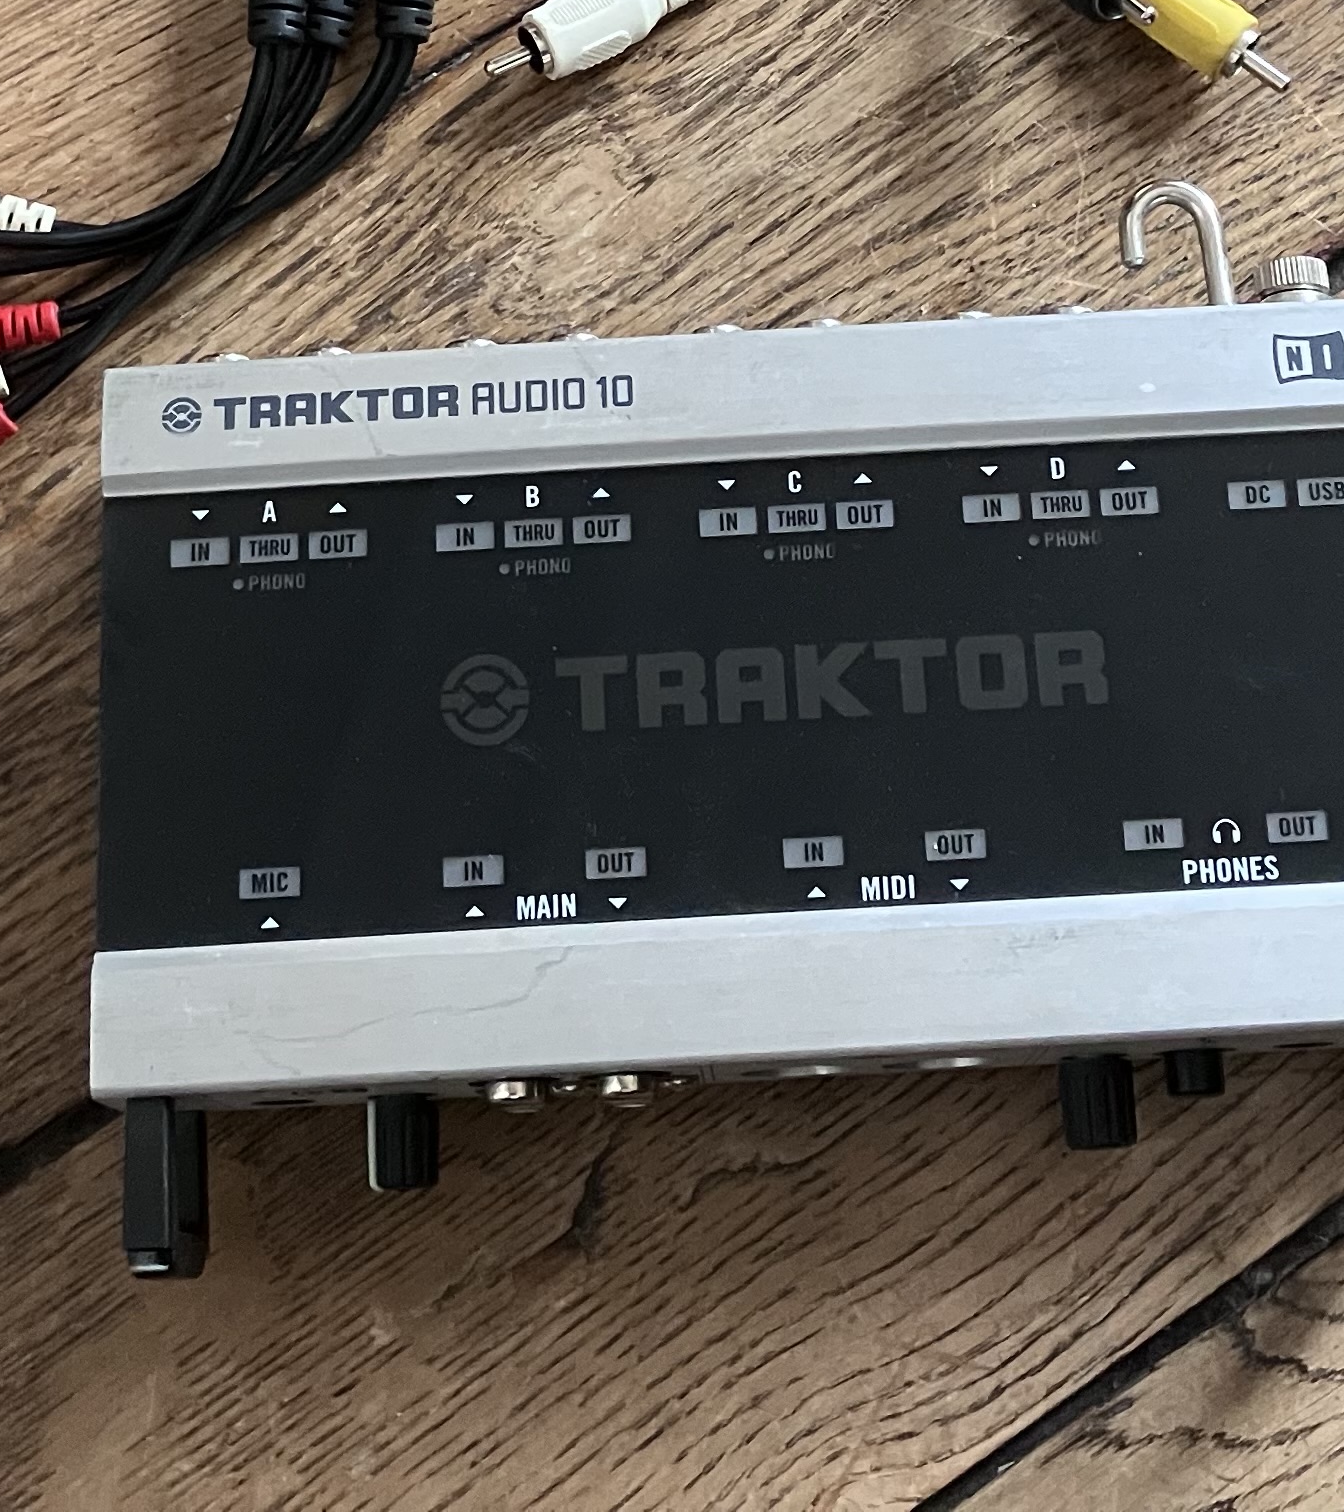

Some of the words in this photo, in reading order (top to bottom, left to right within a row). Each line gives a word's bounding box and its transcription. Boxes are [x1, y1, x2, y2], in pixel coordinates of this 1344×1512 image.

[213, 382, 459, 431] TRAKTOR
[471, 377, 586, 415] AUDIO
[594, 374, 635, 408] 10
[1050, 458, 1066, 481] D
[787, 471, 803, 494] C
[524, 485, 541, 508] B
[1039, 493, 1084, 514] THRU
[1111, 490, 1148, 511] OUT
[1244, 485, 1270, 505] DC
[261, 500, 278, 523] A
[846, 504, 883, 525] OUT
[982, 496, 1003, 517] IN
[583, 518, 621, 538] OUT
[718, 512, 739, 532] IN
[774, 507, 819, 528] THRU
[455, 526, 476, 546] IN
[512, 521, 556, 542] THRU
[189, 541, 211, 562] IN
[248, 537, 292, 559] THRU
[319, 534, 357, 554] OUT
[514, 557, 572, 577] PHONO
[247, 572, 306, 592] PHONO
[554, 629, 1109, 732] TRAKTOR
[1143, 824, 1165, 845] IN
[1278, 817, 1317, 838] OUT
[803, 842, 824, 863] IN
[936, 834, 974, 856] OUT
[463, 861, 484, 881] IN
[596, 852, 635, 873] OUT
[1182, 854, 1280, 885] PHONES
[250, 872, 289, 893] MIC
[860, 874, 916, 902] MIDI
[516, 893, 578, 920] MAIN
